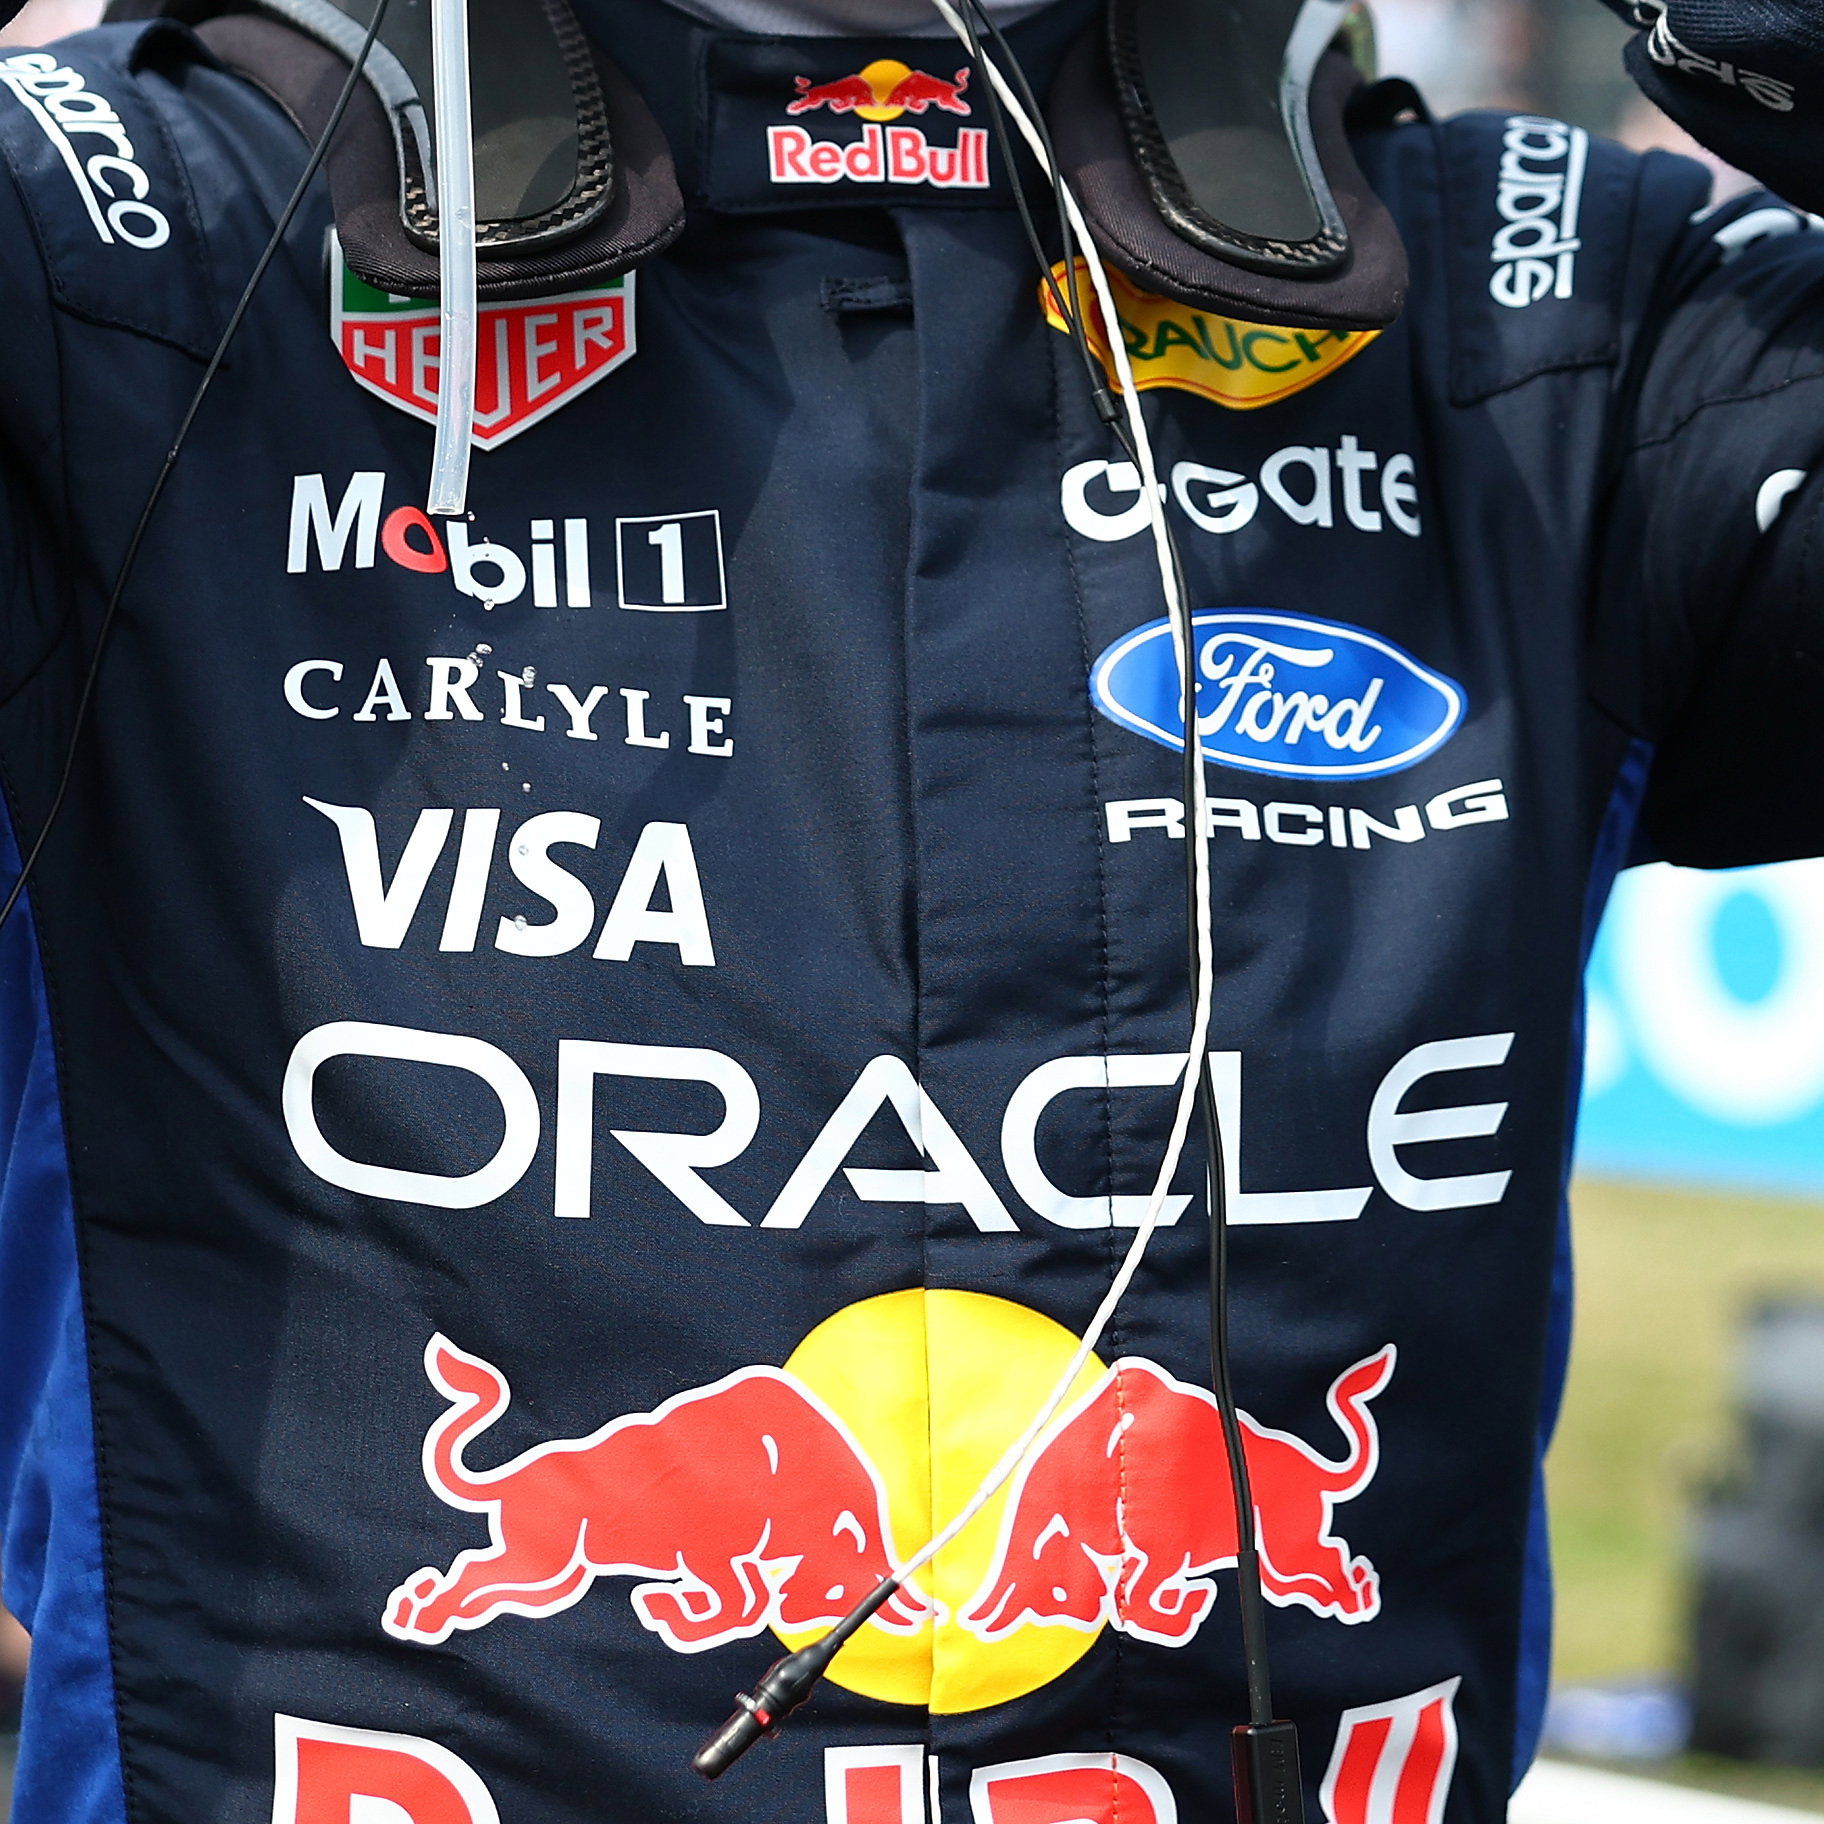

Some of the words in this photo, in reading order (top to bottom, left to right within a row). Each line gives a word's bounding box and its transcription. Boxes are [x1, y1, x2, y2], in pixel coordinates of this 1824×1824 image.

[770, 126, 883, 181] Red
[887, 127, 988, 186] Bull
[1489, 115, 1582, 308] sparco
[287, 471, 592, 608] Mobil
[648, 522, 686, 604] 1
[1171, 434, 1422, 537] Gate
[283, 657, 734, 757] CARLYLE
[1179, 632, 1384, 753] Ford
[1104, 778, 1510, 850] RACING
[302, 795, 716, 967] VISA
[280, 1019, 1516, 1233] ORACLE
